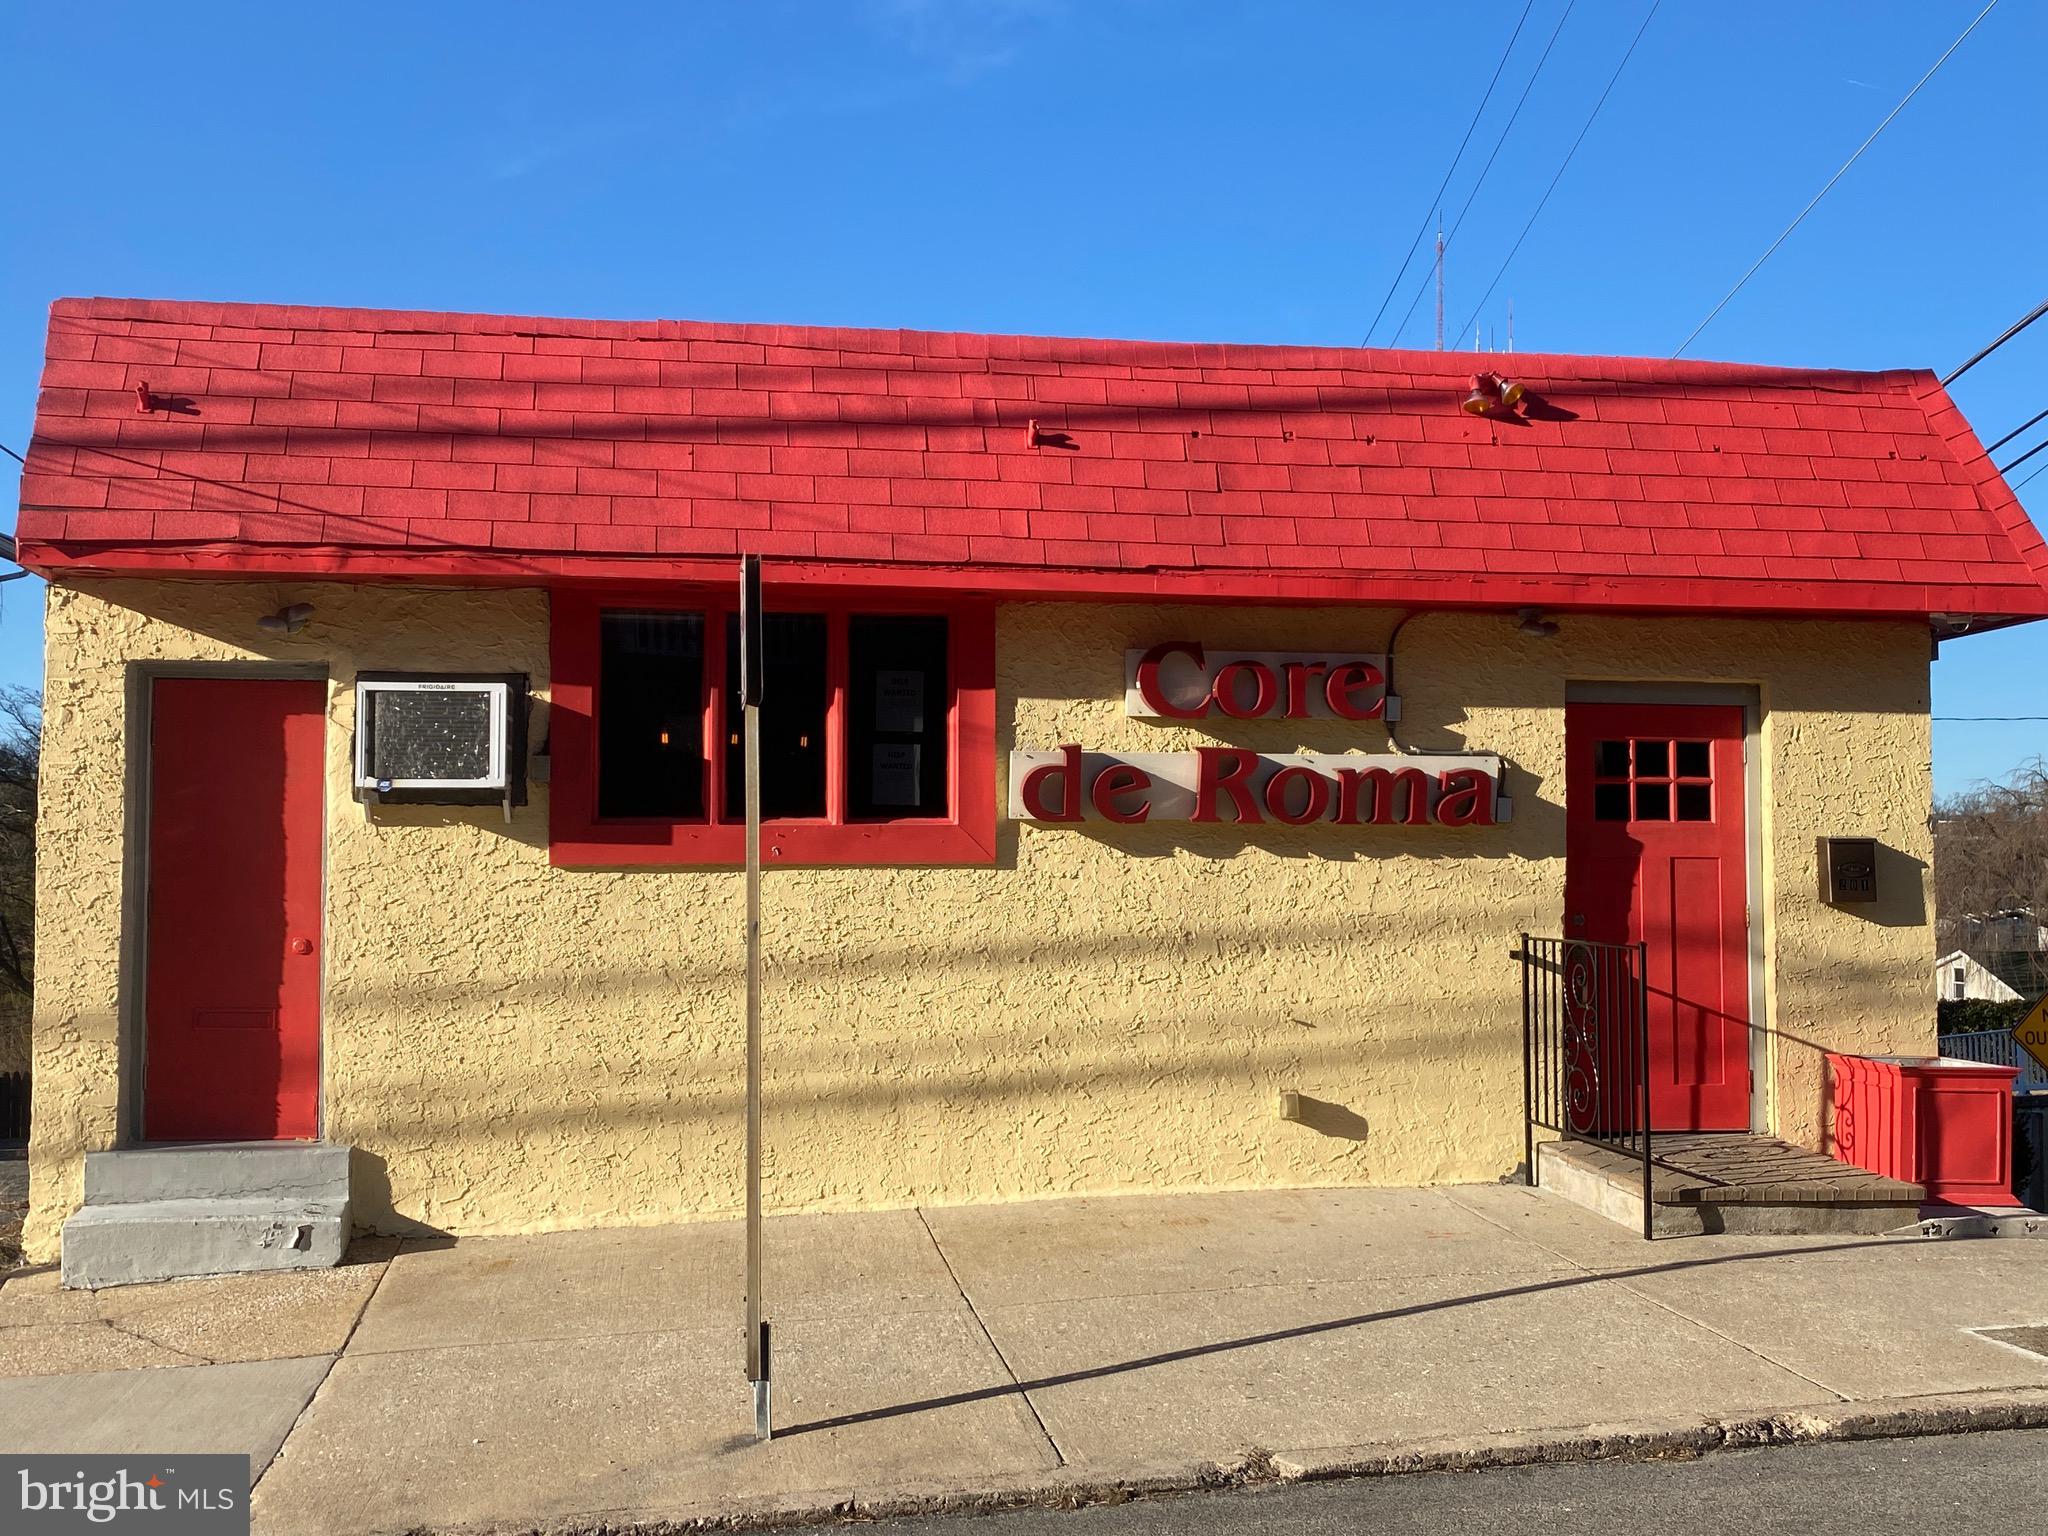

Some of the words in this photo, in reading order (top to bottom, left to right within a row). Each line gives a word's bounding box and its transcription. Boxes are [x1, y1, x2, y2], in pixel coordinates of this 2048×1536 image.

[1135, 640, 1387, 721] Core
[1021, 743, 1153, 825] de
[1188, 746, 1497, 827] Roma
